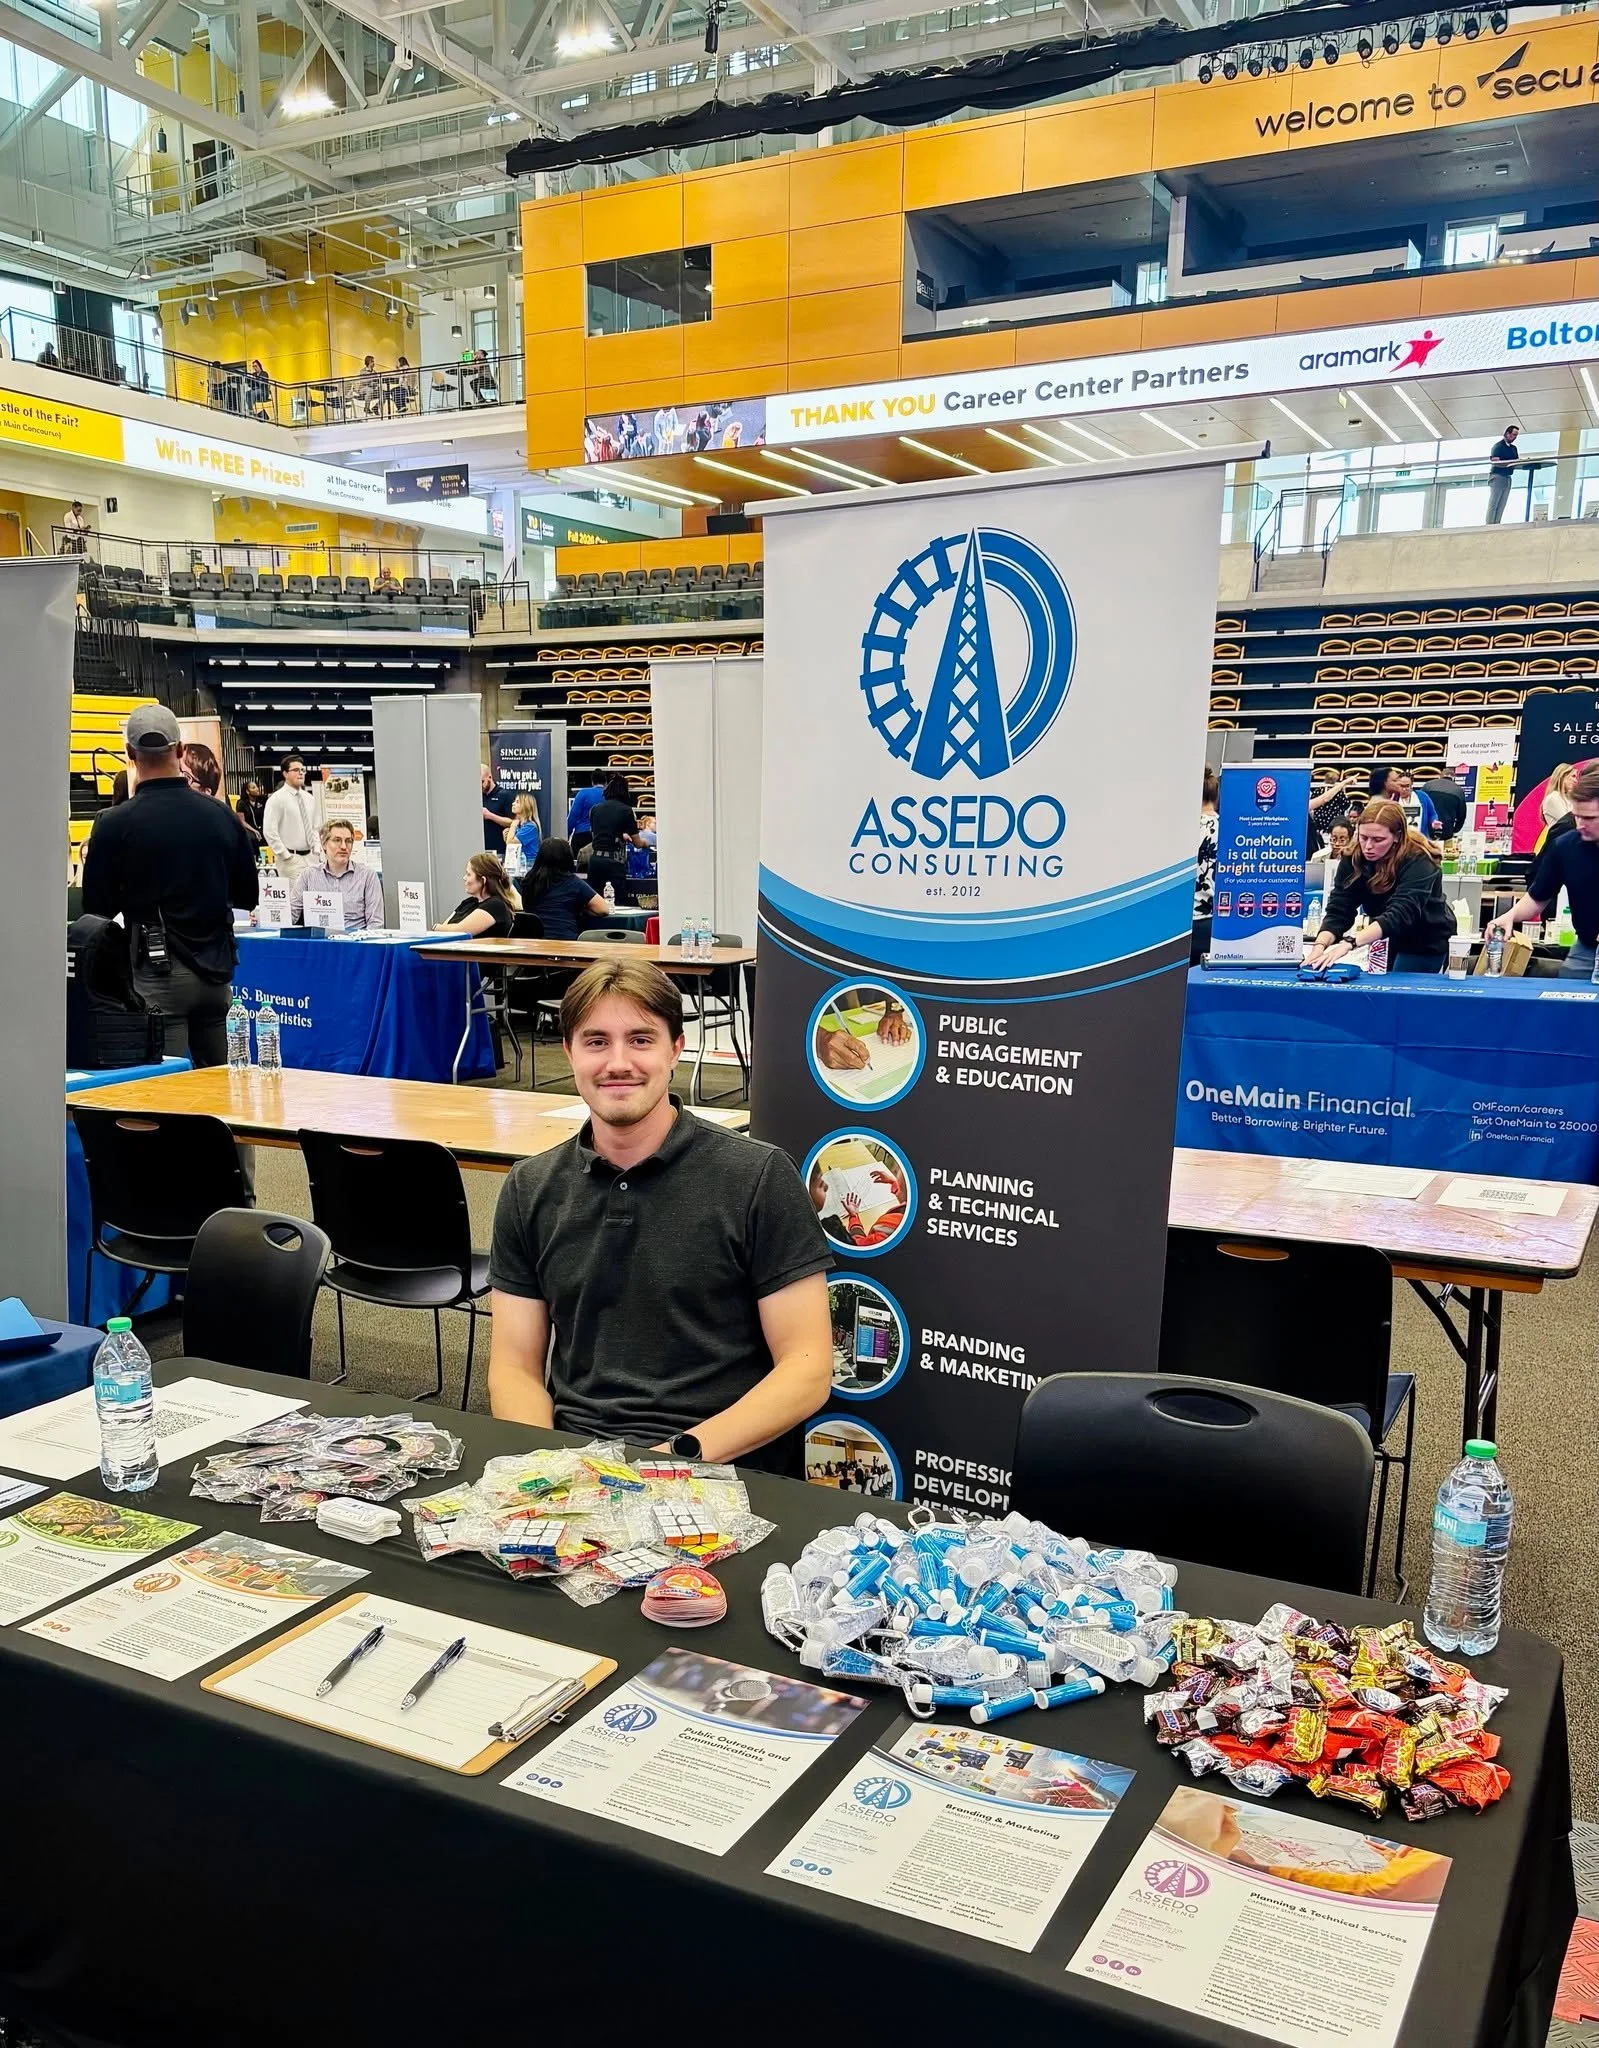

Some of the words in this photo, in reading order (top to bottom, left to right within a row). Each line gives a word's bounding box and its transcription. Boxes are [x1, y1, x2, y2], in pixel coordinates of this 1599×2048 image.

[1255, 93, 1415, 138] welcome
[1428, 83, 1467, 111] to
[1491, 65, 1584, 100] secu
[1506, 321, 1599, 350] Bolto
[1299, 340, 1403, 371] aramark
[790, 401, 876, 428] THANK
[882, 393, 936, 419] YOU
[943, 386, 1027, 412] Career
[1034, 374, 1124, 401] Center
[1131, 362, 1250, 391] Partners
[23, 408, 33, 418] of
[36, 410, 52, 422] the
[56, 414, 79, 427] Fair?
[155, 437, 192, 466] Win
[198, 447, 245, 477] FREE
[250, 459, 305, 488] Prizes!
[327, 475, 335, 484] at
[336, 477, 347, 487] the
[349, 480, 371, 493] Career
[526, 514, 538, 529] TU
[567, 530, 578, 543] Fall
[500, 748, 537, 756] SINCLAIR
[500, 769, 520, 780] We've
[521, 770, 532, 781] got
[533, 772, 537, 780] a
[518, 780, 528, 790] for
[528, 779, 541, 792] you!
[850, 795, 1067, 849] ASSEDO
[1235, 835, 1292, 846] OneMain
[849, 853, 1064, 878] CONSULTING
[1228, 849, 1238, 860] is
[1241, 849, 1257, 860] all
[1260, 849, 1298, 860] about
[1218, 862, 1255, 876] bright
[1258, 862, 1305, 873] futures.
[273, 890, 286, 899] BLS
[409, 892, 419, 900] BLS
[926, 887, 947, 896] est.
[951, 886, 981, 897] 2012
[230, 985, 252, 1000] U.S.
[255, 989, 294, 1007] Bureau
[298, 996, 310, 1009] of
[939, 1014, 1008, 1036] PUBLIC
[937, 1040, 1083, 1070] ENGAGEMENT
[935, 1066, 950, 1084] &
[956, 1067, 1073, 1096] EDUCATION
[1185, 1079, 1300, 1110] OneMain
[1472, 1102, 1564, 1115] OMF.com/careers
[1211, 1112, 1241, 1124] Better
[1244, 1116, 1300, 1131] Borrowing.
[1303, 1120, 1346, 1134] Brighter
[1348, 1124, 1388, 1136] Future.
[1472, 1116, 1493, 1126] Text
[1495, 1117, 1543, 1128] OneMain
[1545, 1119, 1557, 1129] to
[1559, 1121, 1598, 1133] 25000
[1486, 1131, 1519, 1141] OneMain
[1520, 1134, 1555, 1143] Financial
[930, 1167, 1034, 1198] PLANNING
[928, 1193, 943, 1211] &
[948, 1195, 1060, 1228] TECHNICAL
[926, 1217, 1018, 1247] SERVICES
[921, 1328, 1026, 1364] BRANDING
[919, 1353, 935, 1371] &
[939, 1356, 1042, 1391] MARKETIN
[942, 1531, 965, 1540] ASSEDO
[197, 1590, 237, 1605] Construction
[237, 1601, 268, 1614] Outreach
[370, 1614, 397, 1625] ASSEDO
[585, 1725, 637, 1744] ASSEDO
[684, 1726, 715, 1740] Public
[717, 1736, 766, 1755] Outreach
[768, 1752, 791, 1762] and
[678, 1733, 764, 1762] Communications
[834, 1808, 892, 1827] CONSULTING
[837, 1802, 897, 1823] ASSEDO
[945, 1803, 993, 1822] Branding
[994, 1816, 1004, 1825] &
[1005, 1820, 1061, 1840] Marketing
[1128, 1895, 1195, 1919] CONSULTING
[1130, 1889, 1199, 1914] ASSEDO
[1250, 1891, 1297, 1911] Planning
[1299, 1906, 1308, 1914] &
[1310, 1909, 1360, 1930] Technical
[1361, 1925, 1408, 1944] Services
